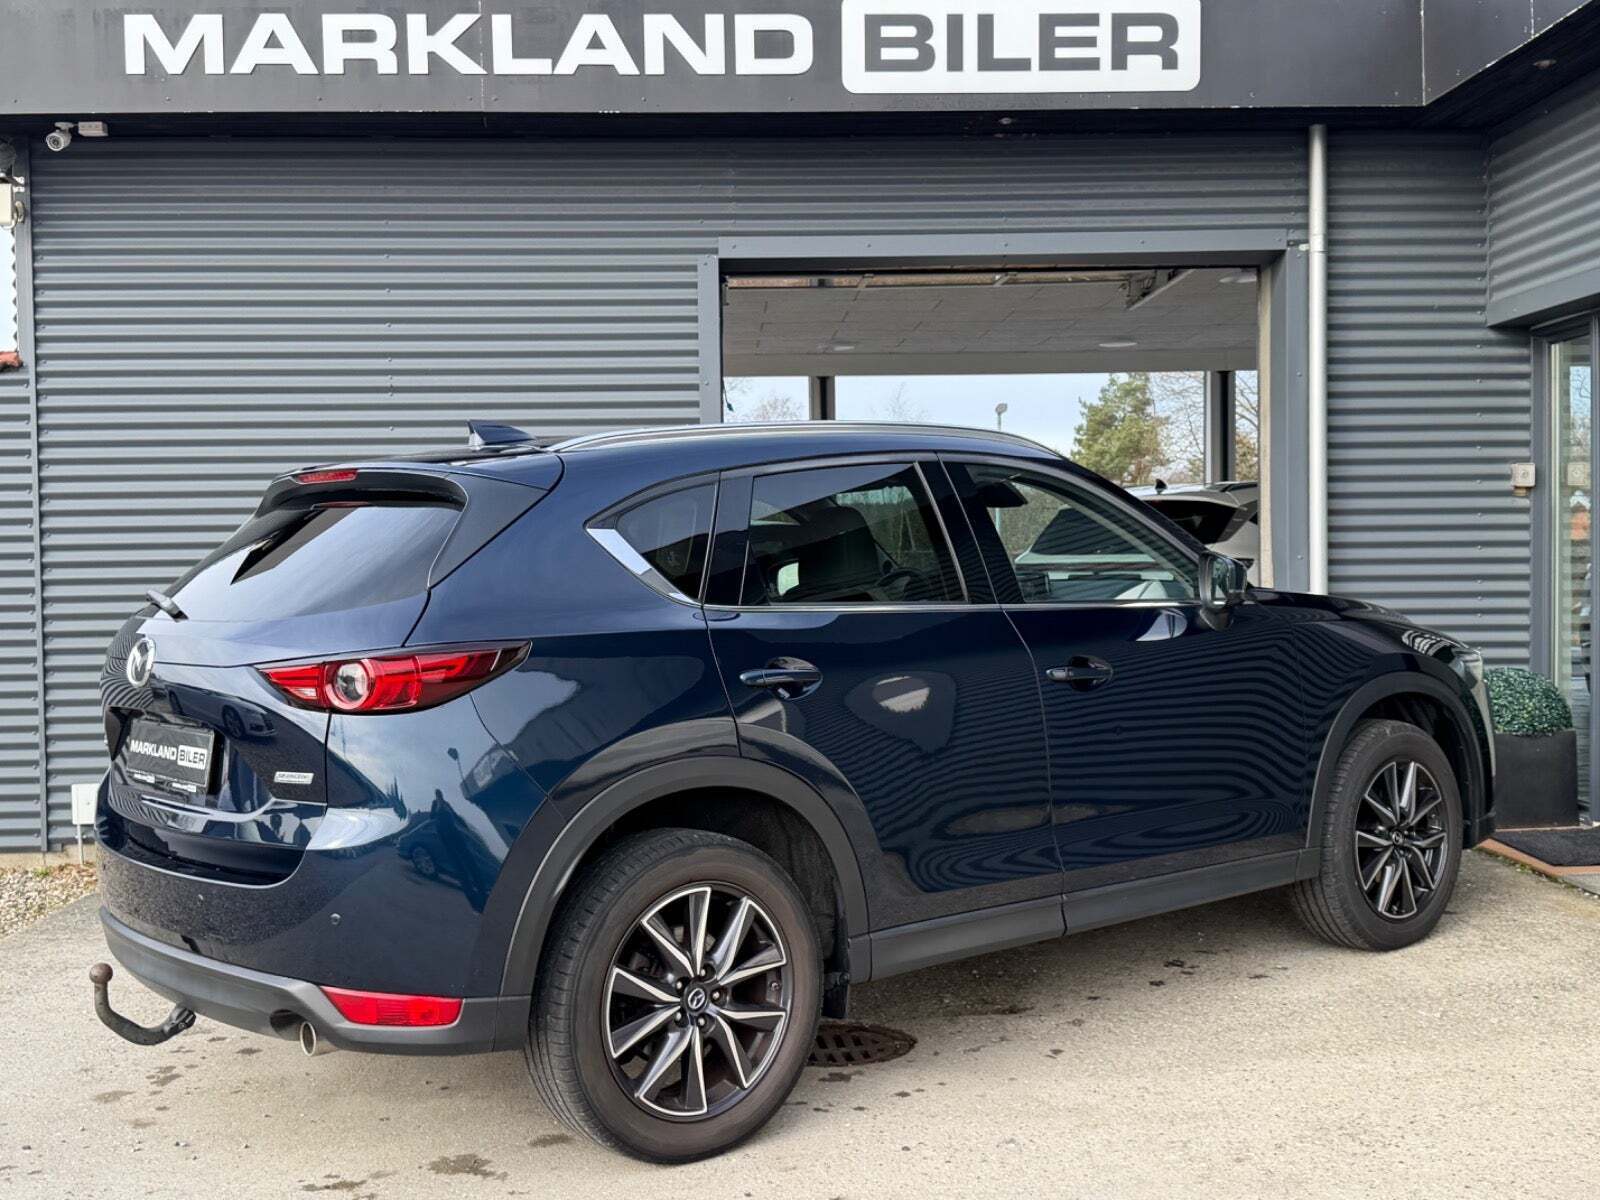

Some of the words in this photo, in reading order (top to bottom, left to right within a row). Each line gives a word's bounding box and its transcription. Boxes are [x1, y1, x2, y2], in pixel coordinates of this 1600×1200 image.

[123, 13, 814, 76] MARKLAND
[864, 12, 1179, 72] BILER
[130, 739, 177, 761] MARKLAND
[179, 748, 206, 767] BILER
